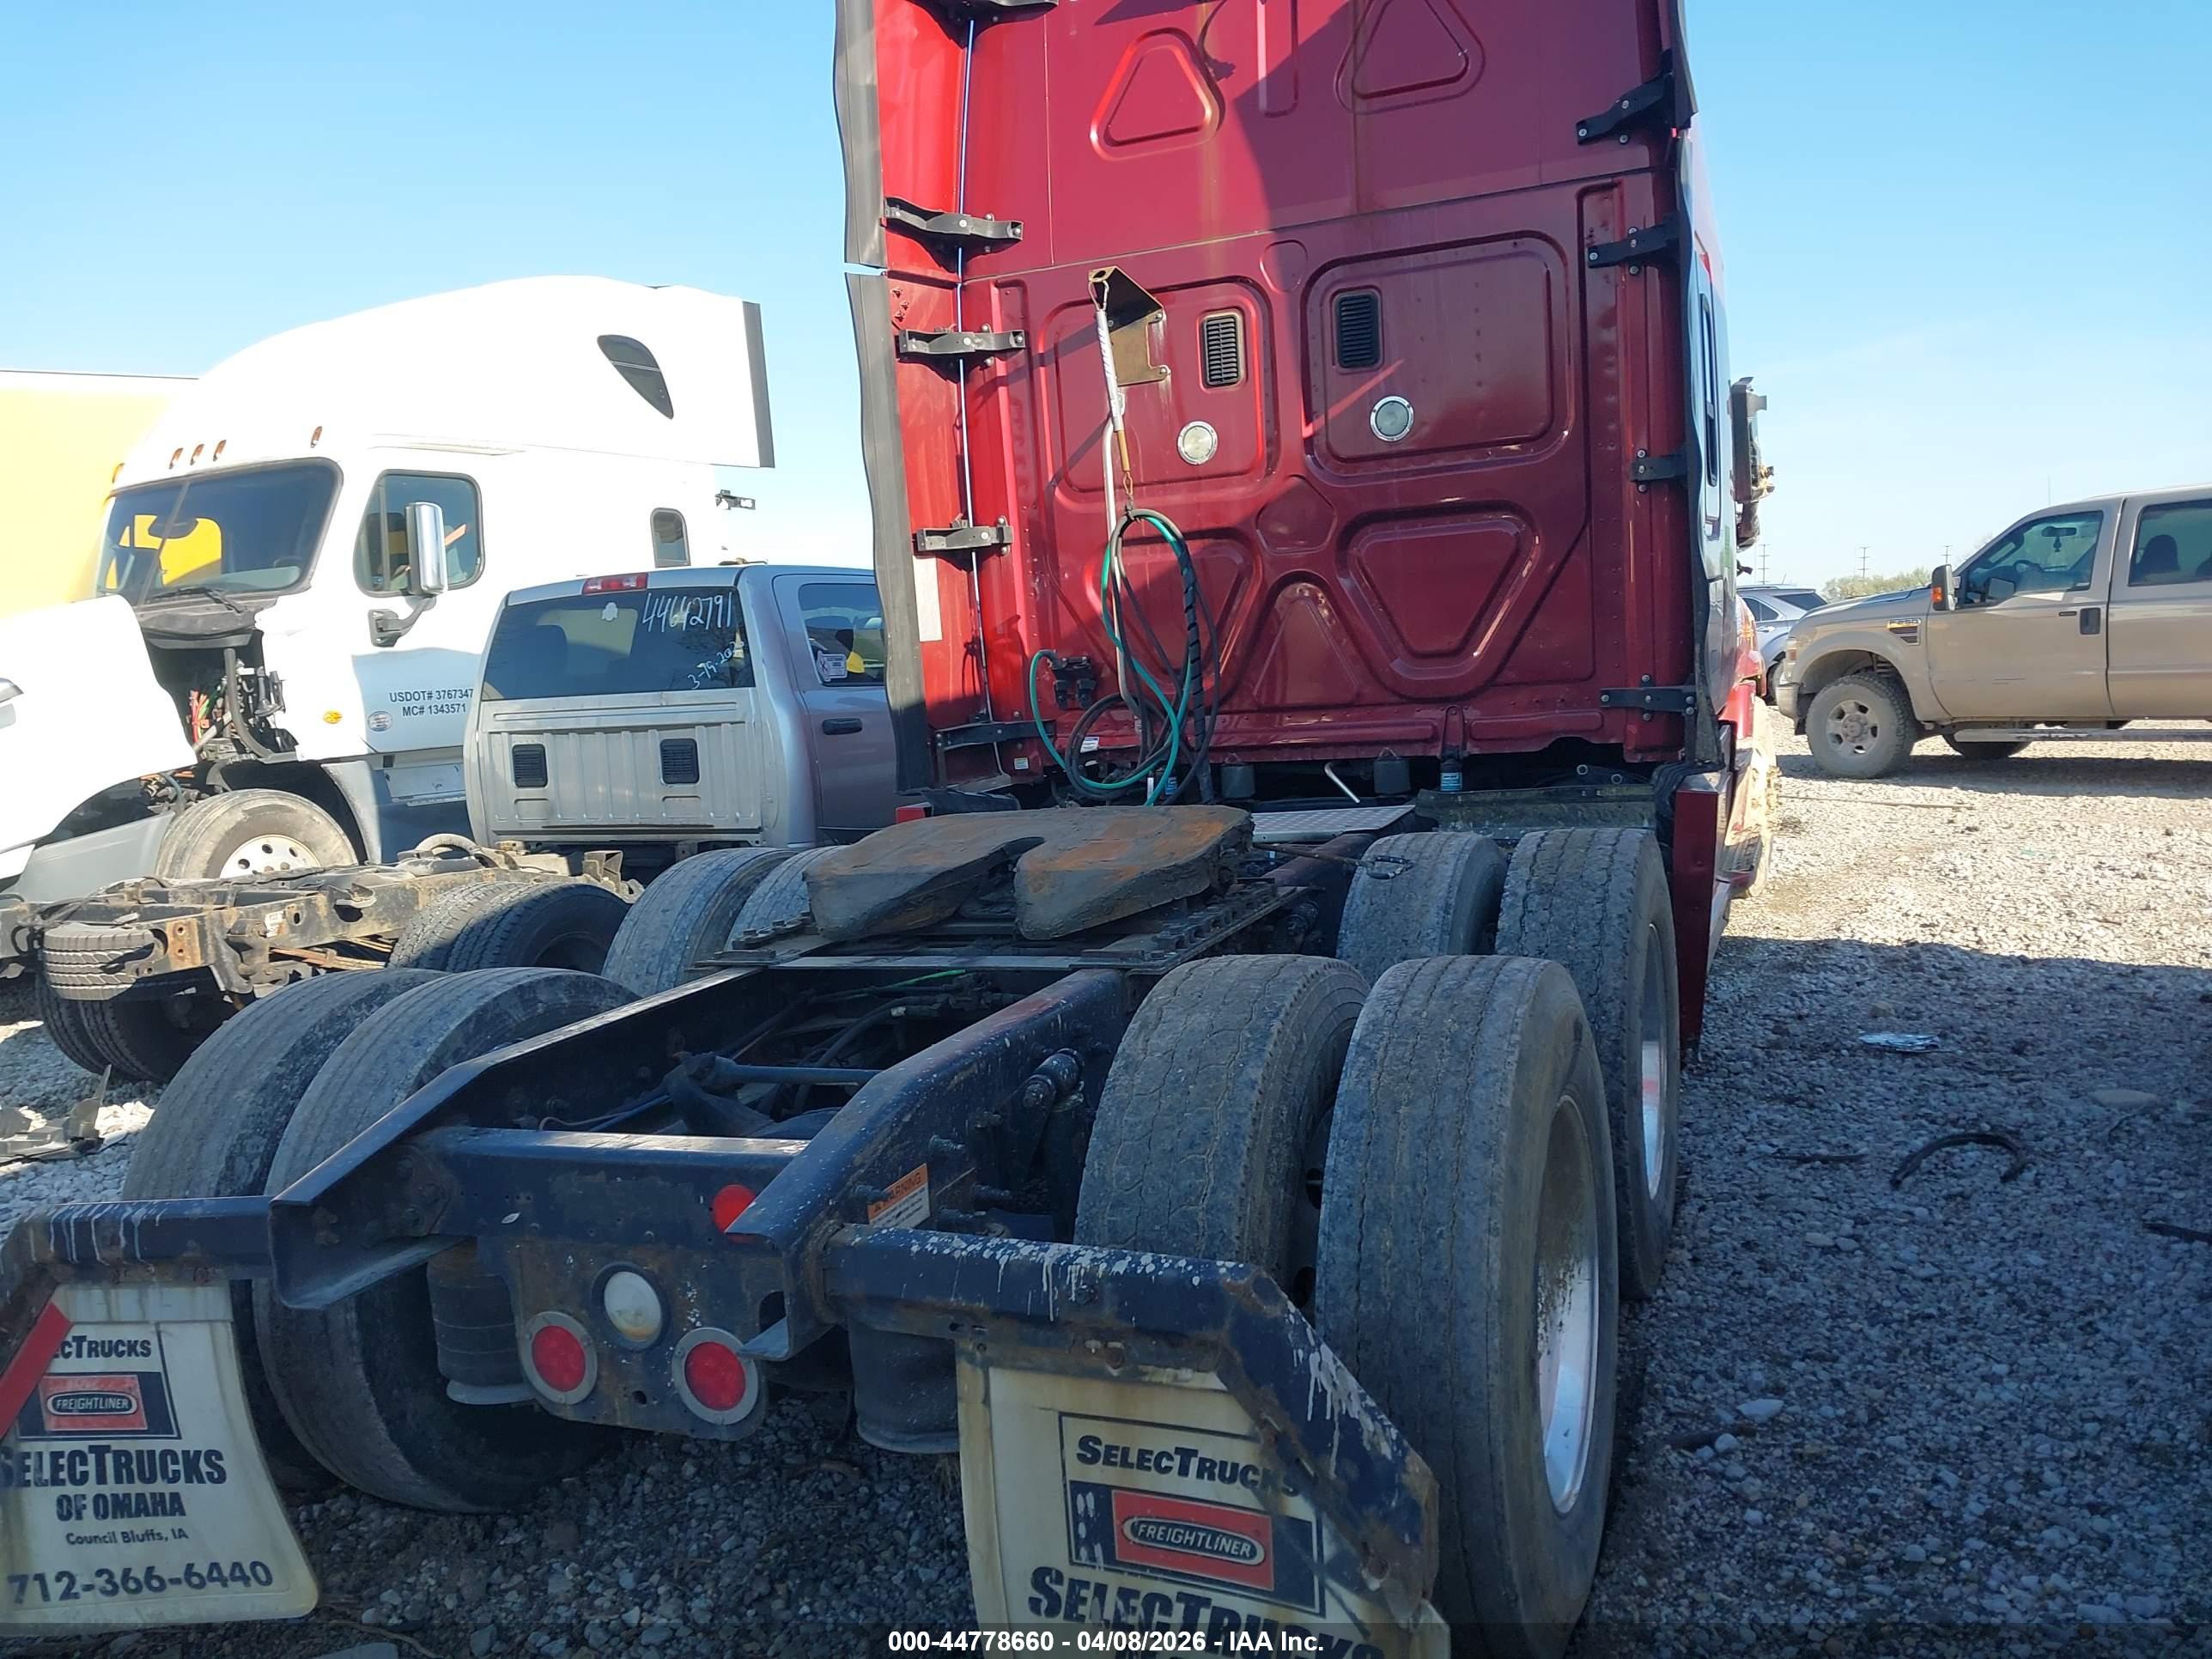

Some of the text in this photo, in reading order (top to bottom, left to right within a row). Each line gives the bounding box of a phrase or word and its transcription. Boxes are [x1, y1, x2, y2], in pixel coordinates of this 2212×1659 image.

[389, 688, 474, 702] USDOT# 3767347
[402, 703, 465, 716] MC# 1343571
[884, 1171, 922, 1203] ARNING
[56, 1396, 130, 1411] FREIGHTLINER
[56, 1492, 187, 1522] OF OMAHA
[65, 1528, 189, 1545] Council Bluffs, IA
[1137, 1522, 1251, 1559] FREIGHTLINER
[7, 1560, 273, 1604] 712-366-6440
